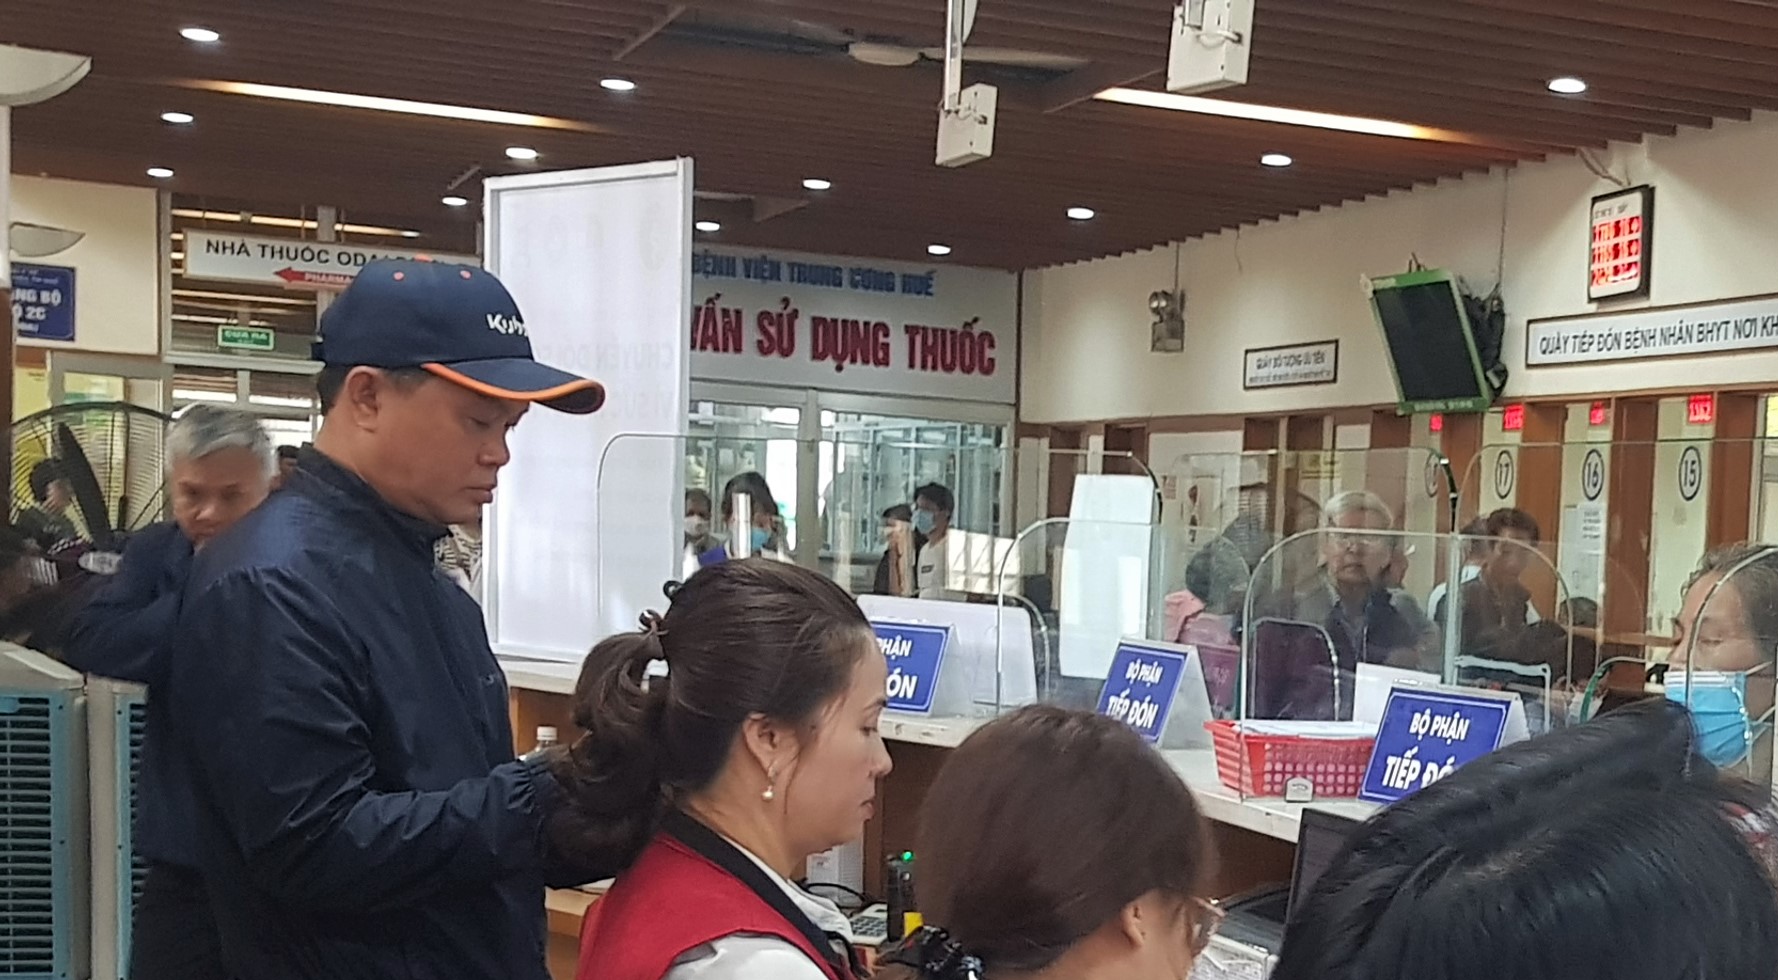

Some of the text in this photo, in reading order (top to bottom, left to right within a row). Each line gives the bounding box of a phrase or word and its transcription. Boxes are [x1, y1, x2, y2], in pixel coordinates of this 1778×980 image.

[206, 237, 250, 257] NHÀ
[743, 254, 782, 286] VIỆN
[787, 259, 844, 289] TRUNG
[902, 268, 938, 298] HUẾ
[11, 287, 37, 303] NG
[757, 296, 799, 359] SỬ
[811, 315, 891, 373] DỤNG
[904, 316, 996, 376] THUỐC
[1697, 319, 1731, 344] BHYT
[1586, 454, 1600, 487] 16
[1683, 458, 1698, 489] 15
[886, 667, 918, 700] ÓN
[1138, 661, 1163, 688] PHẬN
[1128, 697, 1159, 730] ĐÓN
[1409, 707, 1471, 746] BỘ PHẬN
[1381, 745, 1422, 791] TIẾP
